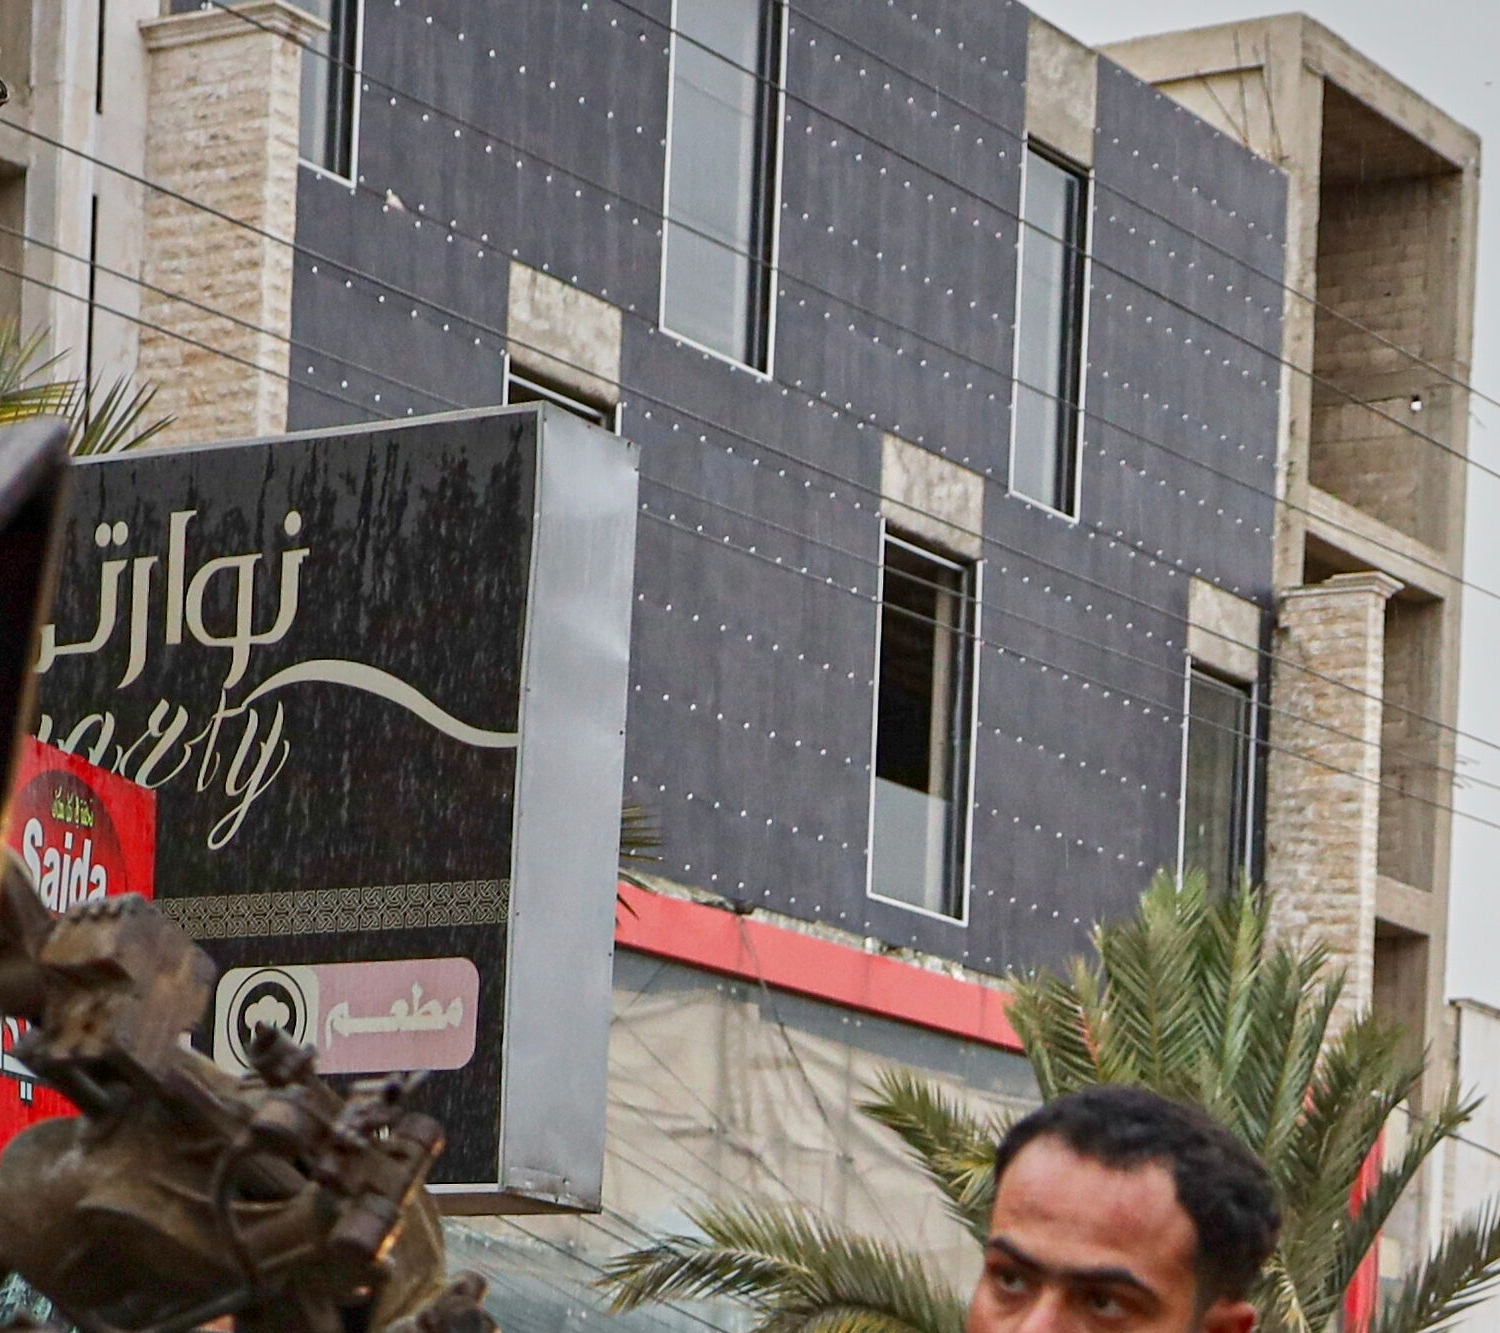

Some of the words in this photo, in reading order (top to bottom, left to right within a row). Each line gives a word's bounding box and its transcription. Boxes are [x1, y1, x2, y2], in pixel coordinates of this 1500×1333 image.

[33, 508, 311, 691] نوارت
[22, 817, 108, 914] Saida
[324, 980, 465, 1051] مطعم
